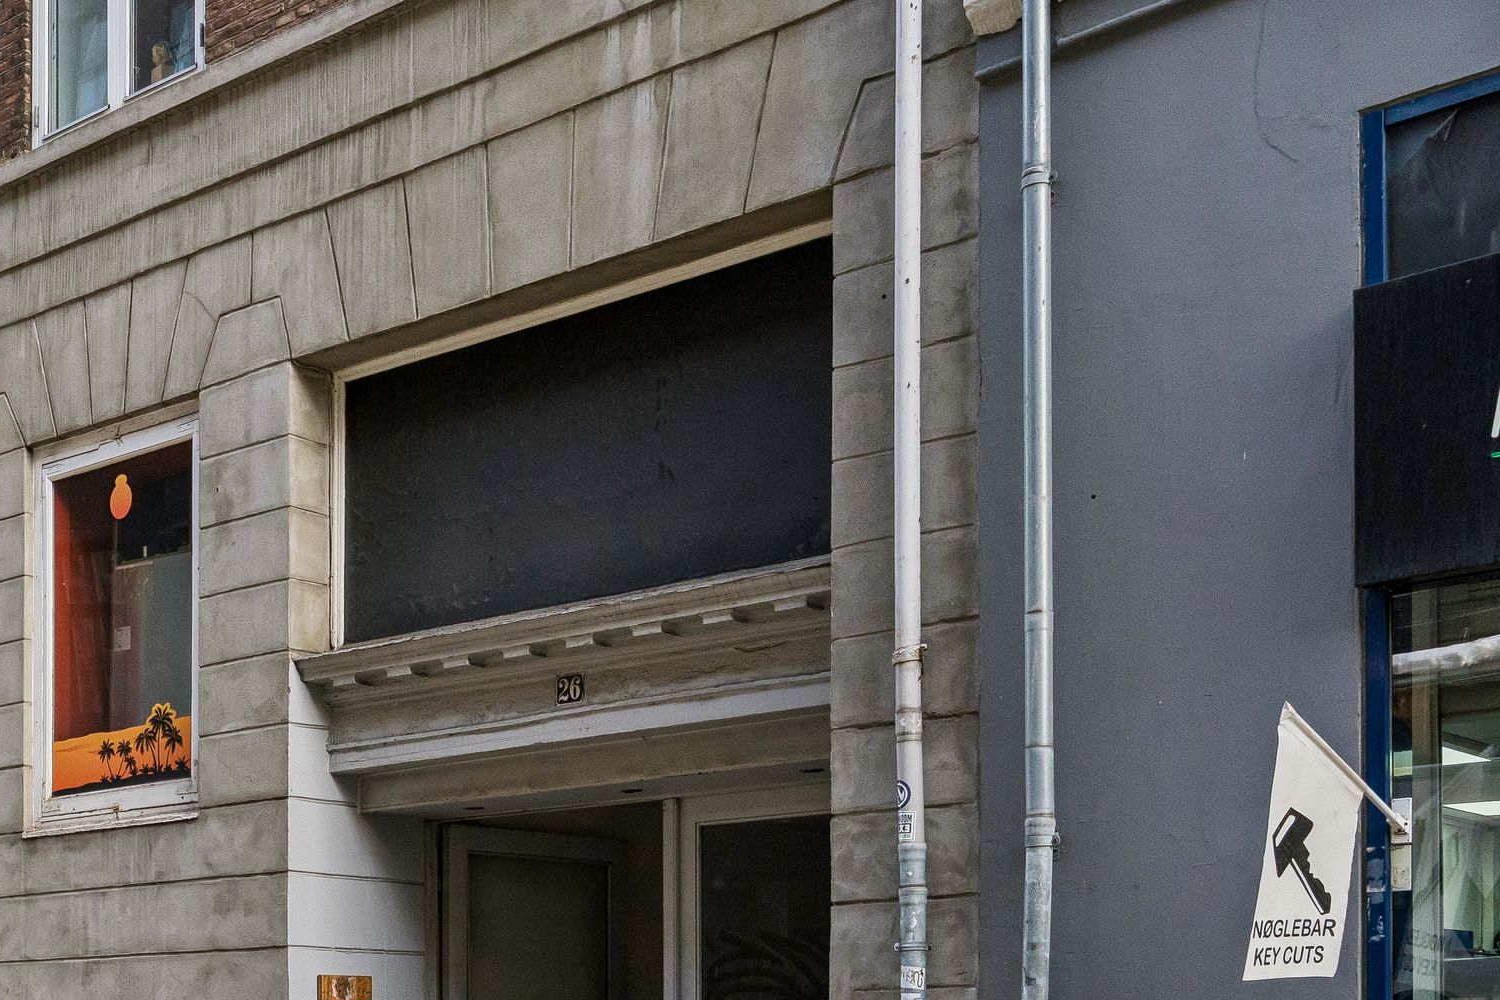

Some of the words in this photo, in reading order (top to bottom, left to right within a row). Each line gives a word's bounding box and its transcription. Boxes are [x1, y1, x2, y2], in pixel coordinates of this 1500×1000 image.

[558, 676, 581, 701] 26
[1252, 918, 1337, 940] NØGLEBAR
[1253, 947, 1280, 967] KEY
[1282, 945, 1324, 965] CUTS
